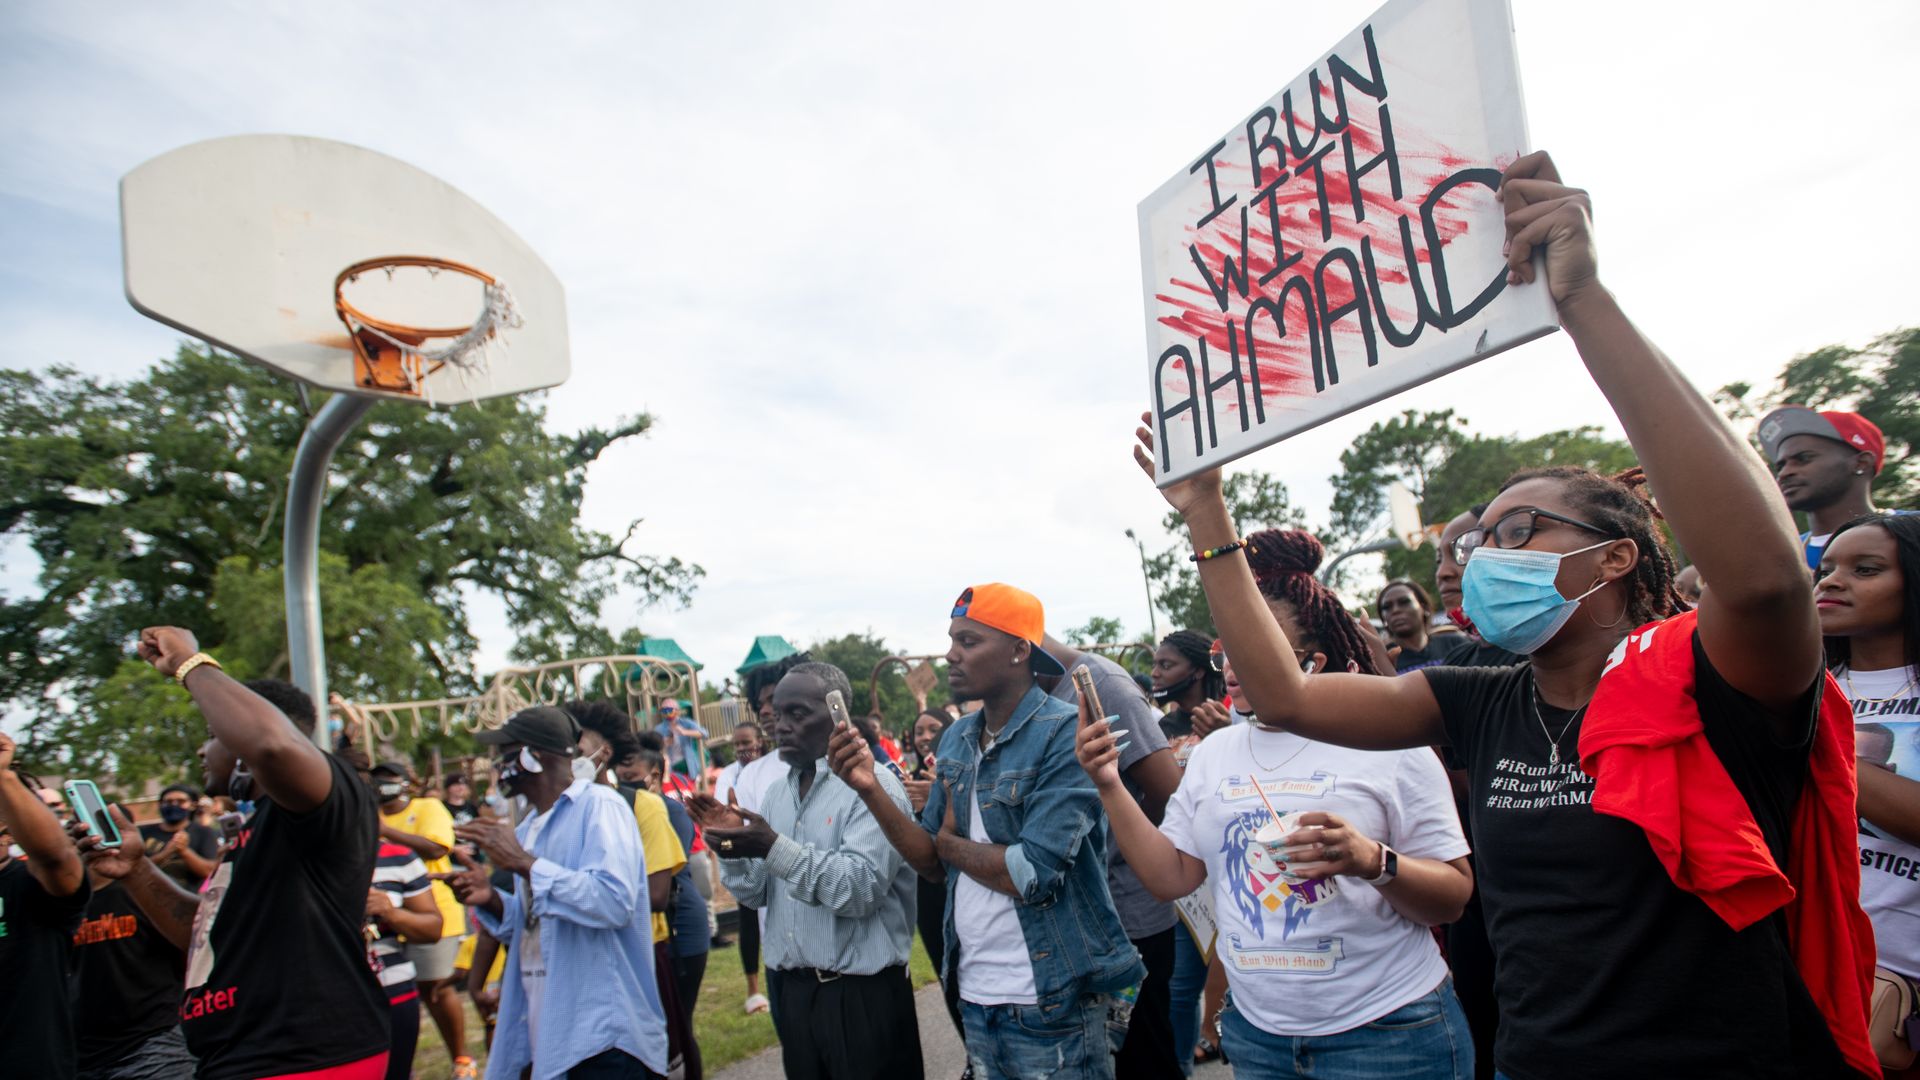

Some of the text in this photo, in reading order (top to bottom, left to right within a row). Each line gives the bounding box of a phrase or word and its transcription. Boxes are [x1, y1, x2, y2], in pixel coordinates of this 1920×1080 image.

[1189, 23, 1388, 229] I RUN
[1189, 103, 1402, 312] WITH
[1155, 168, 1510, 474] AHMAUD
[1858, 846, 1920, 881] STICE
[181, 986, 238, 1020] Later
[1239, 954, 1327, 968] Run With Maud
